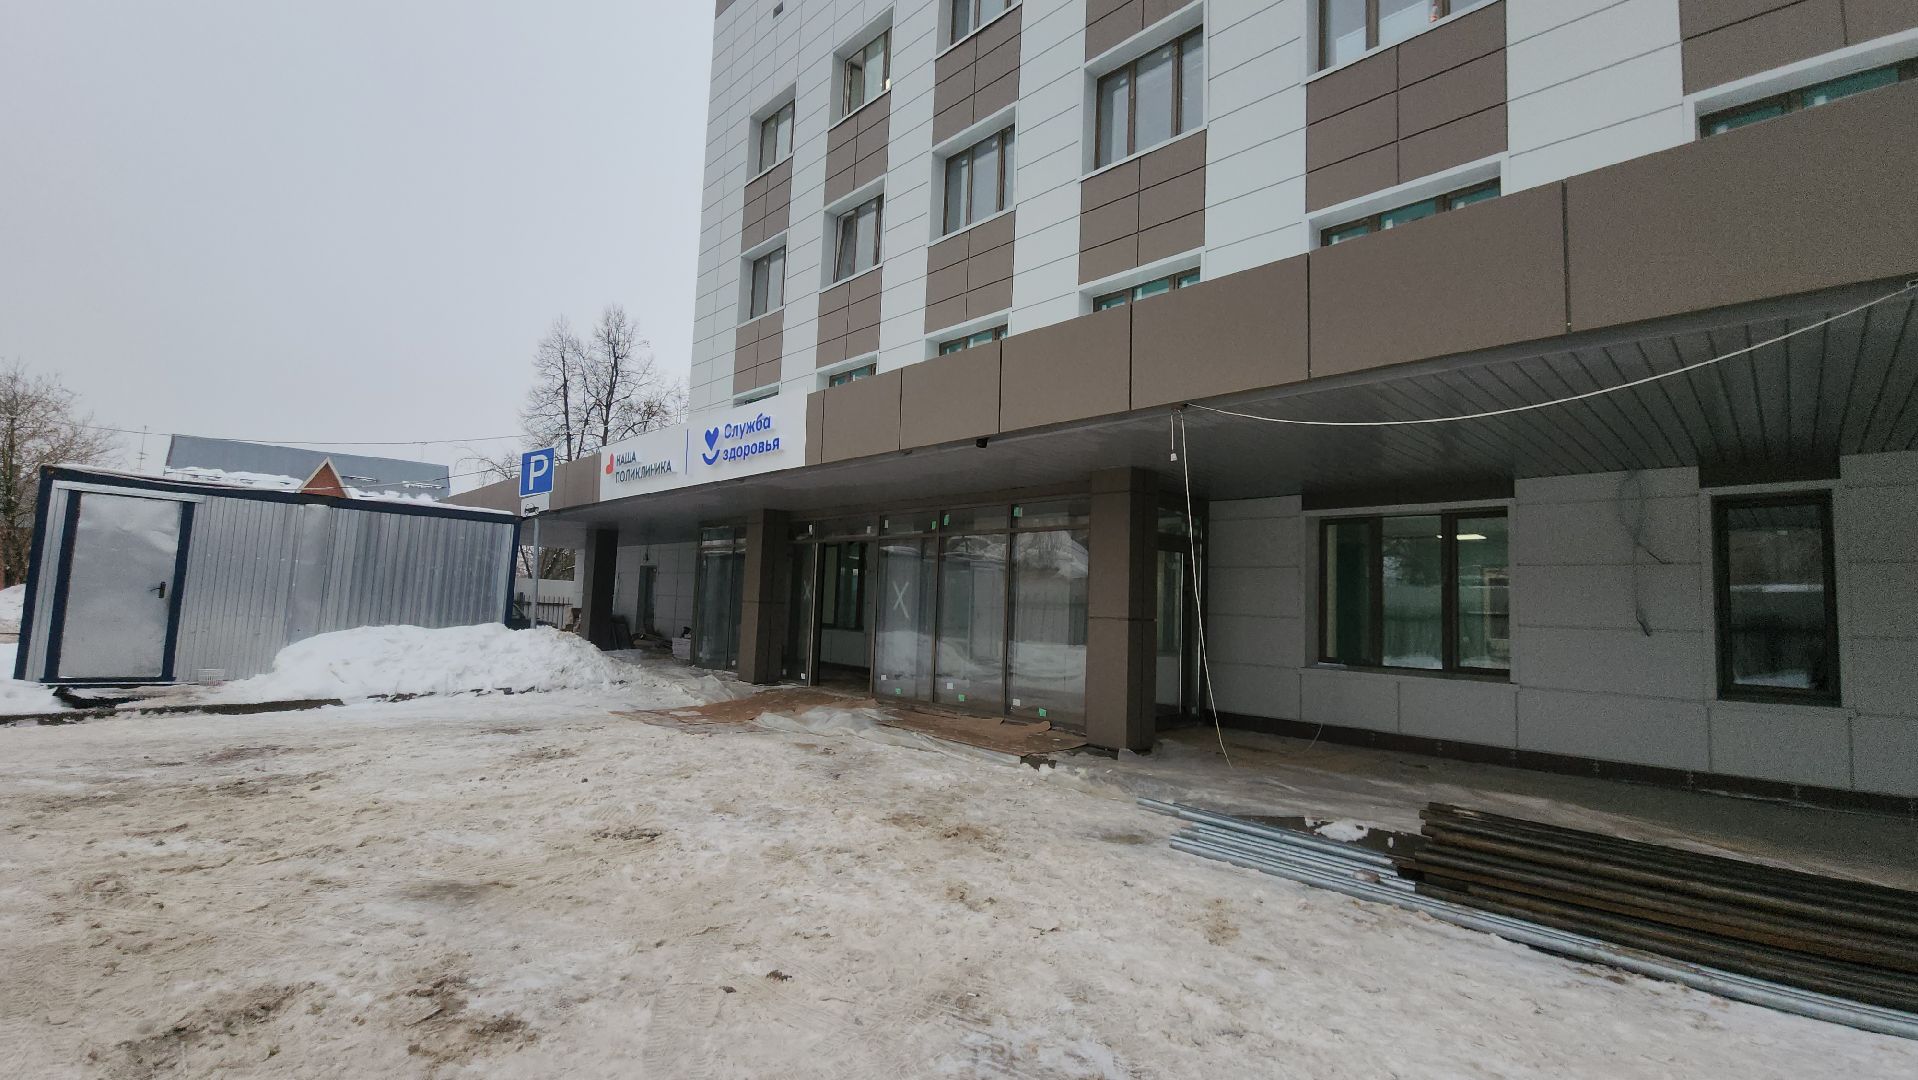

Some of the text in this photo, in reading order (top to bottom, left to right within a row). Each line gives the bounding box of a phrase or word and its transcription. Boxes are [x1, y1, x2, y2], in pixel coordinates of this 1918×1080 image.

[724, 413, 771, 439] Служба
[616, 451, 636, 466] НАША
[723, 437, 780, 461] здоровья
[529, 454, 549, 490] P
[615, 460, 672, 483] ПОЛИКЛИНИКА
